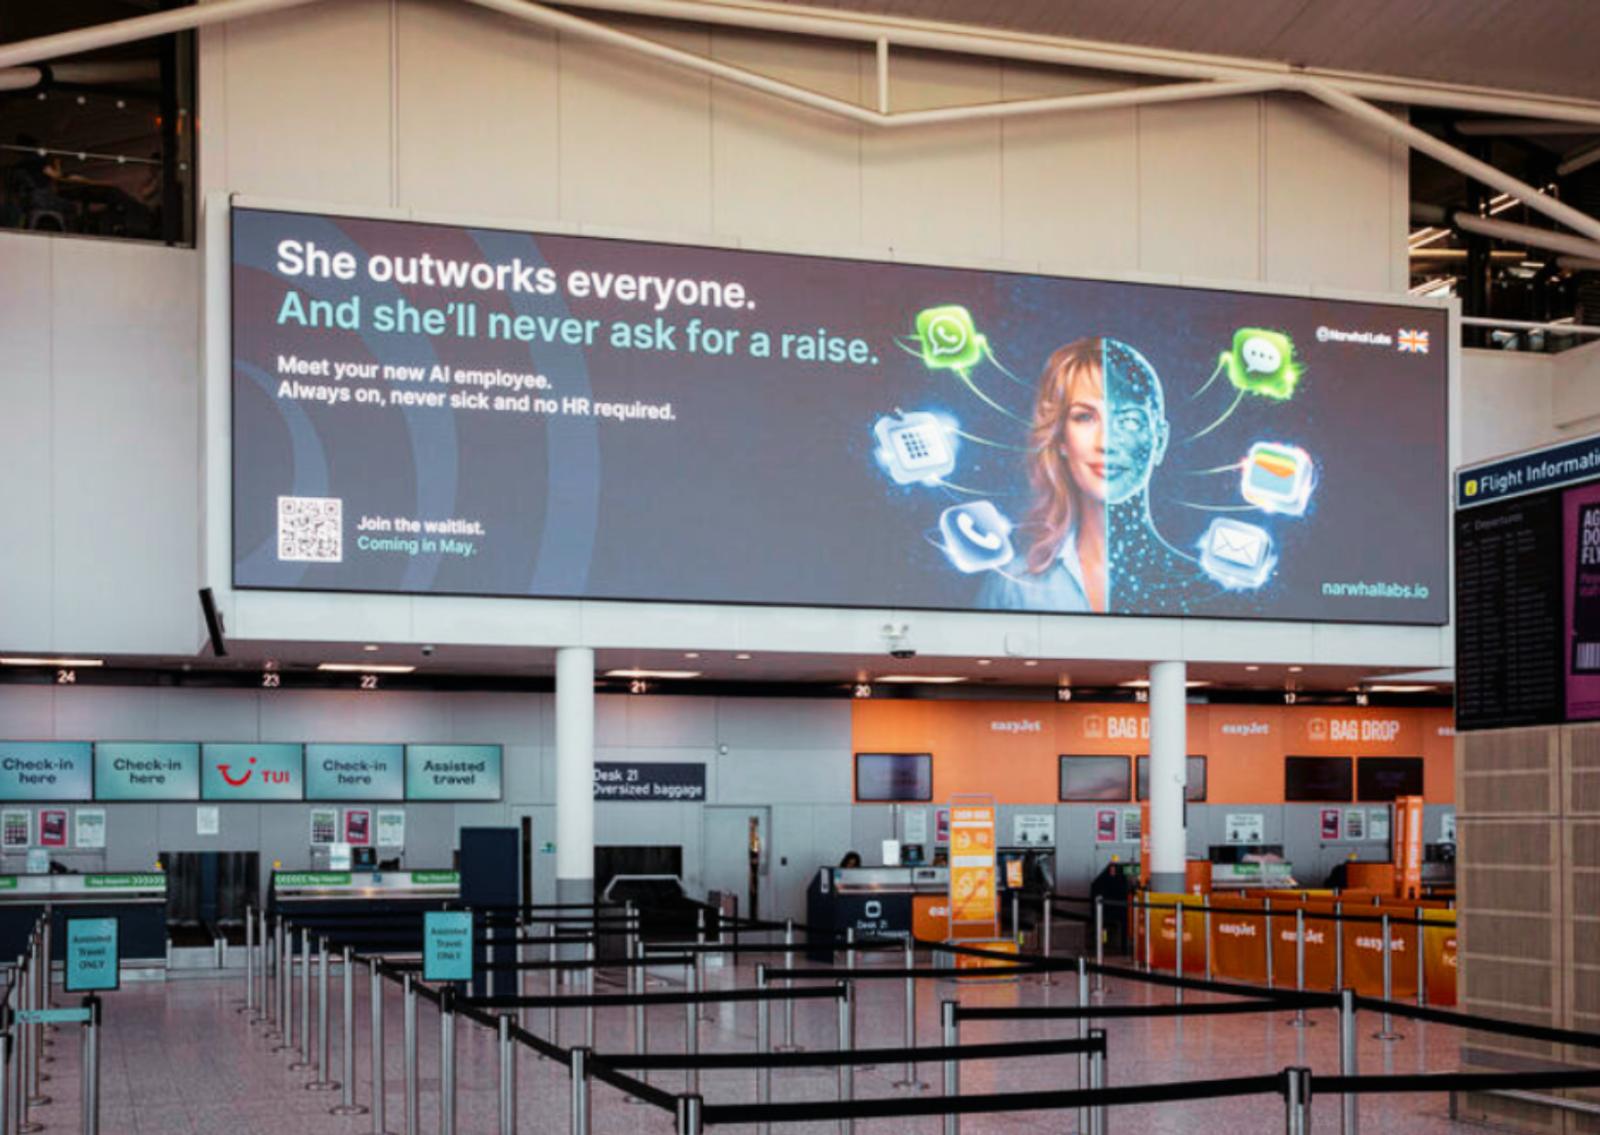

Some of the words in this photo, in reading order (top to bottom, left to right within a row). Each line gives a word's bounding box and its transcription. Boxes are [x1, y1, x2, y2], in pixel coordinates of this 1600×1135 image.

[277, 240, 356, 280] She
[368, 253, 556, 294] outworks
[567, 271, 756, 311] everyone.
[277, 291, 360, 329] And
[373, 299, 476, 337] she’ll
[489, 312, 599, 345] never
[610, 318, 676, 350] ask
[686, 320, 740, 355] for
[750, 331, 770, 357] a
[781, 329, 879, 365] raise.
[277, 355, 329, 375] Meet
[334, 362, 379, 380] your
[384, 365, 424, 381] new
[430, 365, 449, 383] AI
[454, 369, 552, 391] employee.
[277, 380, 350, 404] Always
[355, 387, 386, 407] on,
[391, 390, 446, 406] never
[451, 392, 489, 410] sick
[494, 394, 529, 412] and
[534, 400, 558, 414] no
[563, 397, 590, 415] HR
[594, 401, 676, 421] required.
[1480, 469, 1523, 492] Flight
[357, 516, 392, 531] Join
[394, 517, 420, 532] the
[423, 519, 485, 535] waitlist.
[357, 536, 418, 555] Coming
[421, 538, 436, 552] in
[440, 539, 477, 556] May.
[1322, 581, 1429, 599] narwhallabs.io
[57, 670, 76, 683] 24
[262, 674, 280, 687] 23
[360, 675, 378, 689] 22
[631, 681, 646, 693] 21
[856, 684, 871, 697] 20
[991, 720, 1041, 733] easyJet
[1107, 716, 1137, 738] BAG
[1221, 722, 1270, 736] easyJet
[1330, 719, 1358, 741] BAG
[1362, 720, 1399, 742] DROP
[2, 757, 74, 771] Check-in
[113, 758, 182, 771] Check-in
[322, 760, 387, 772] Check-in
[424, 760, 486, 772] Assisted
[19, 772, 56, 784] here
[130, 772, 166, 784] here
[262, 770, 290, 784] TUI
[338, 774, 371, 785] here
[433, 774, 475, 785] travel
[593, 769, 622, 781] Desk
[627, 769, 638, 781] 21
[653, 783, 702, 798] baggage
[1219, 924, 1256, 937] easyJet
